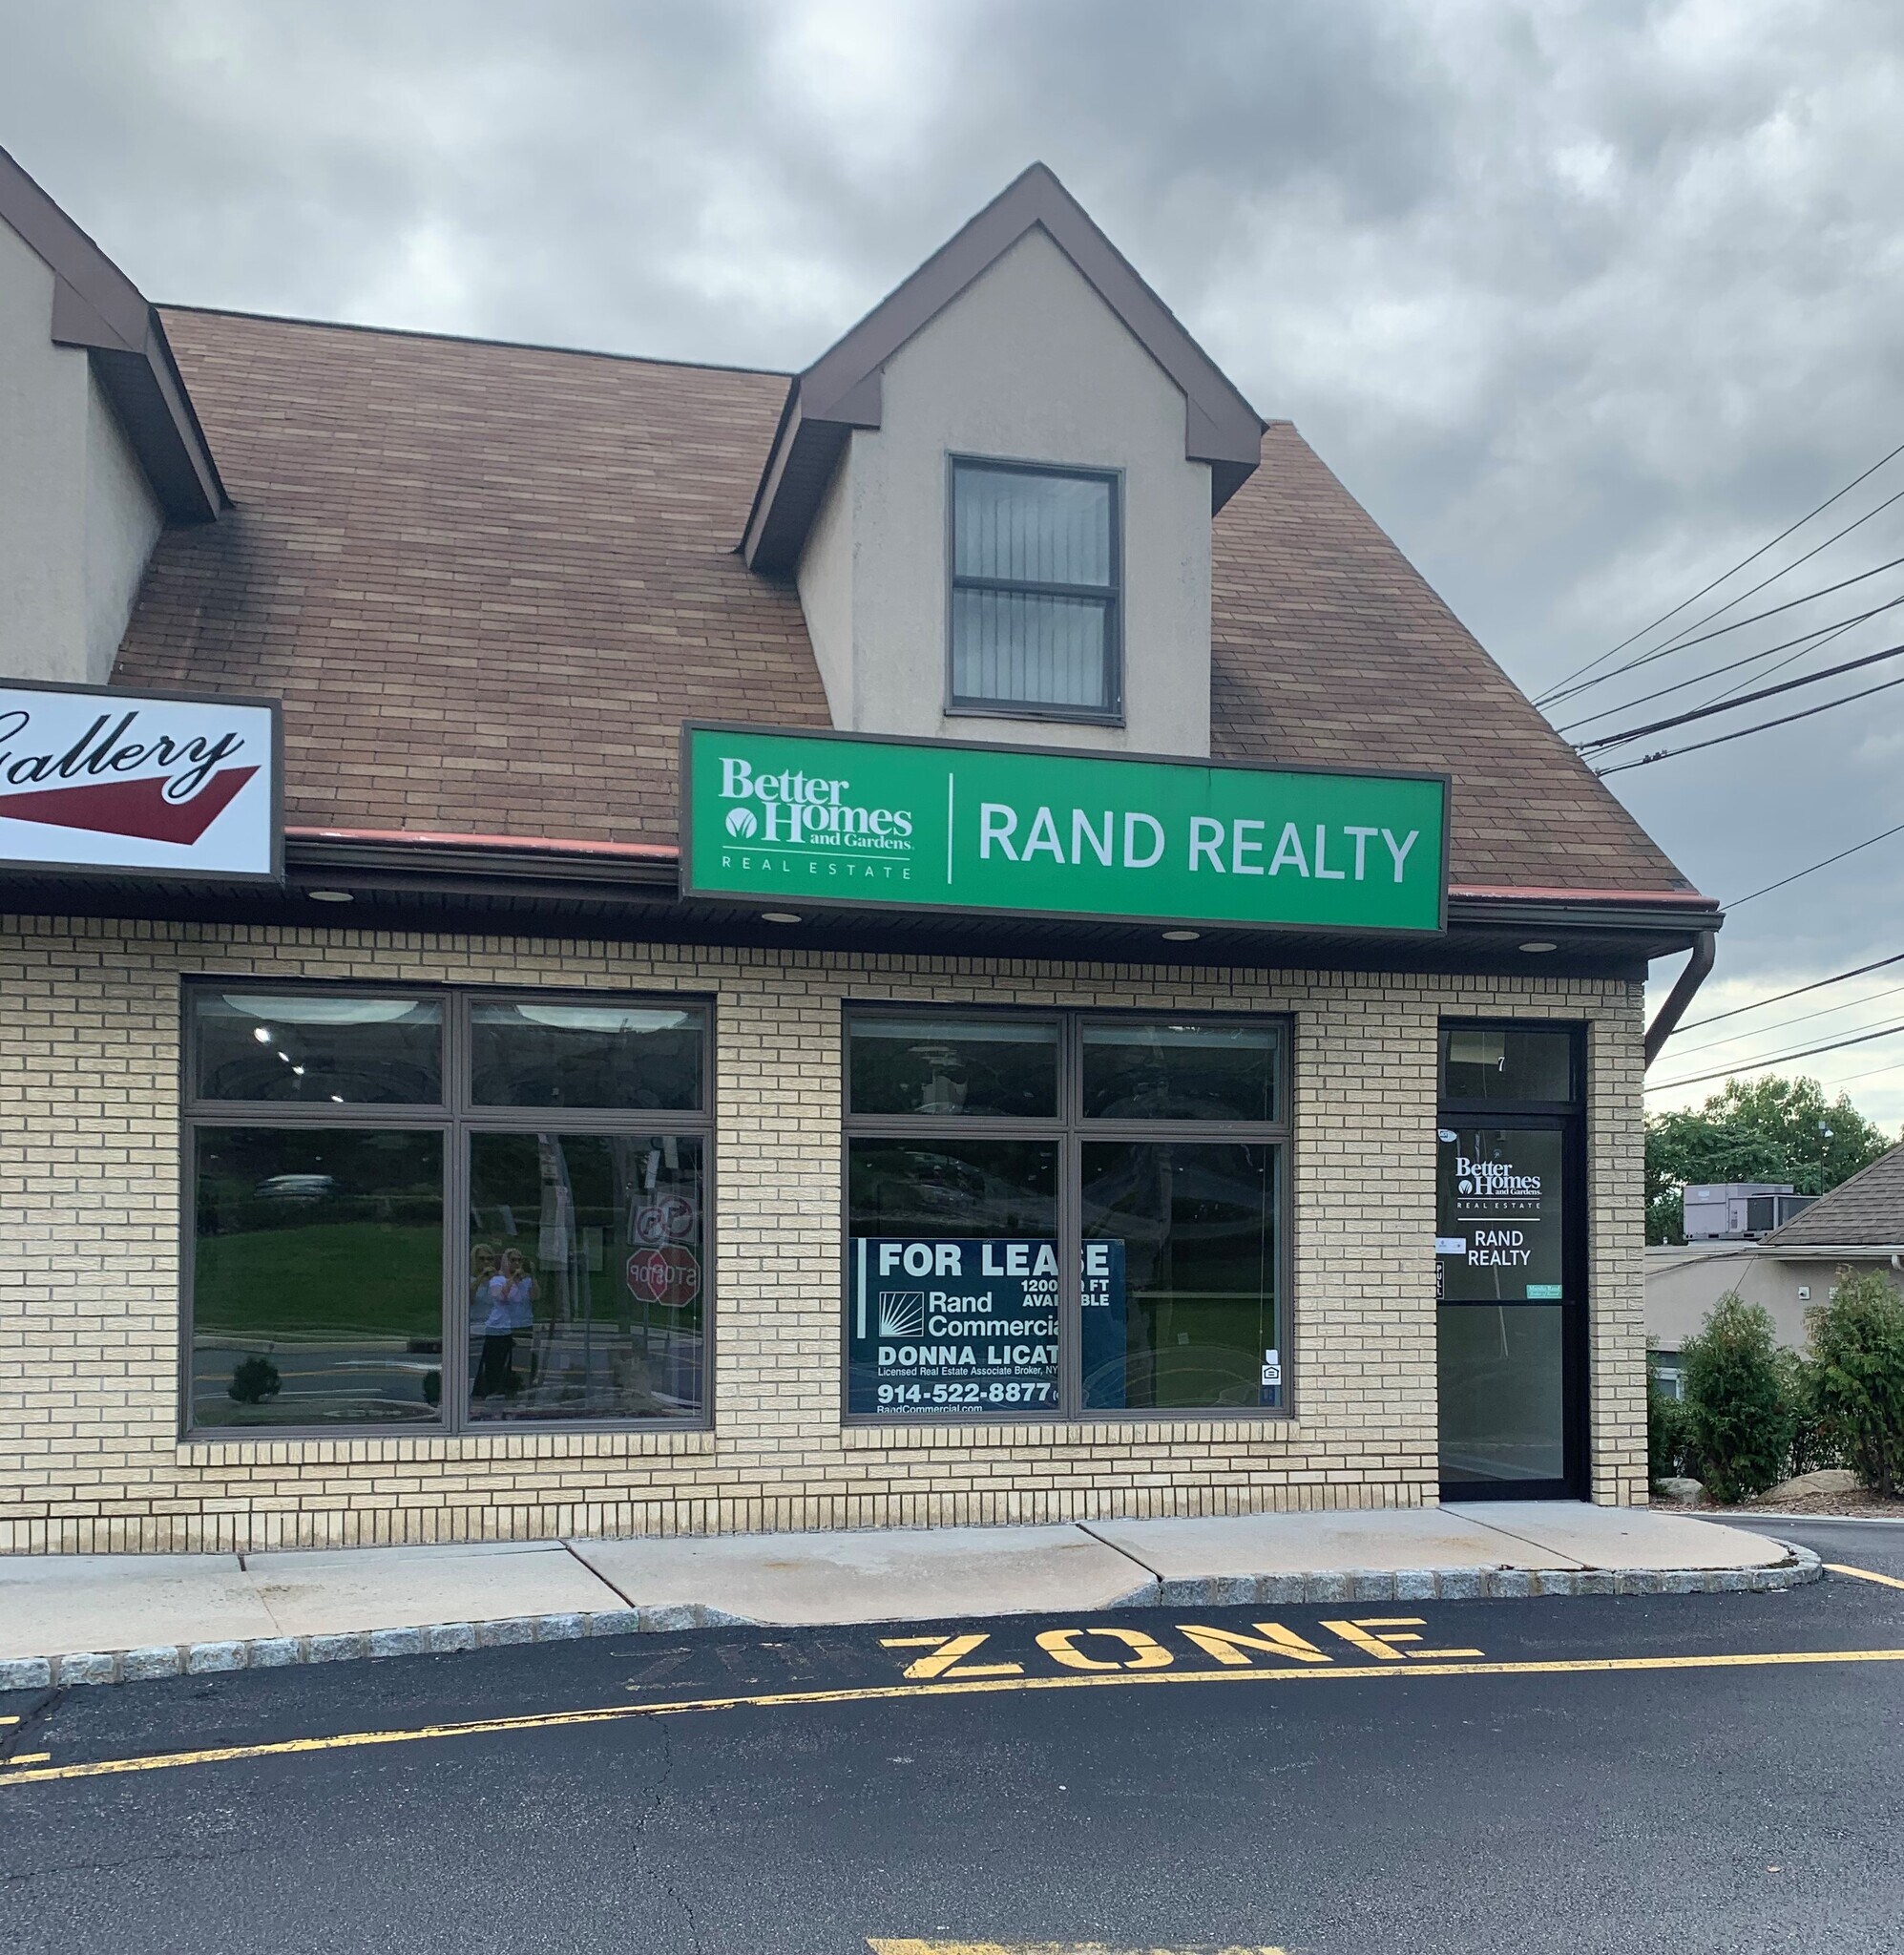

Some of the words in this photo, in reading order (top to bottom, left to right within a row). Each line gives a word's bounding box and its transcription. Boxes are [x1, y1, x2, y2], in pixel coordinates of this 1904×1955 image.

[719, 757, 849, 806] Better
[761, 801, 912, 843] Homes
[810, 832, 841, 846] and
[844, 833, 912, 850] Gardens
[979, 802, 1165, 869] RAND
[1188, 816, 1419, 883] REALTY
[722, 855, 790, 872] REAL
[809, 862, 911, 880] ESTATE
[1497, 1057, 1505, 1072] 7
[1455, 1157, 1513, 1177] Better
[1474, 1176, 1541, 1195] Homes
[1475, 1230, 1523, 1247] RAND
[879, 1243, 962, 1276] FOR
[982, 1244, 1109, 1276] LEAE
[1468, 1250, 1531, 1266] REALTY
[1021, 1279, 1058, 1293] 1200
[1090, 1279, 1109, 1292] FT
[929, 1292, 993, 1313] Rand
[1022, 1293, 1109, 1307] AVAIBLE
[878, 1346, 976, 1366] DONNA
[878, 1367, 917, 1377] Licensed
[920, 1367, 939, 1376] Real
[941, 1367, 968, 1376] Estate
[971, 1366, 1012, 1376] Associate
[1015, 1366, 1043, 1376] Broker,
[877, 1383, 1051, 1403] 914-522-8877
[877, 1404, 983, 1413] RandCommercial.com
[880, 1618, 1485, 1678] ZONE
